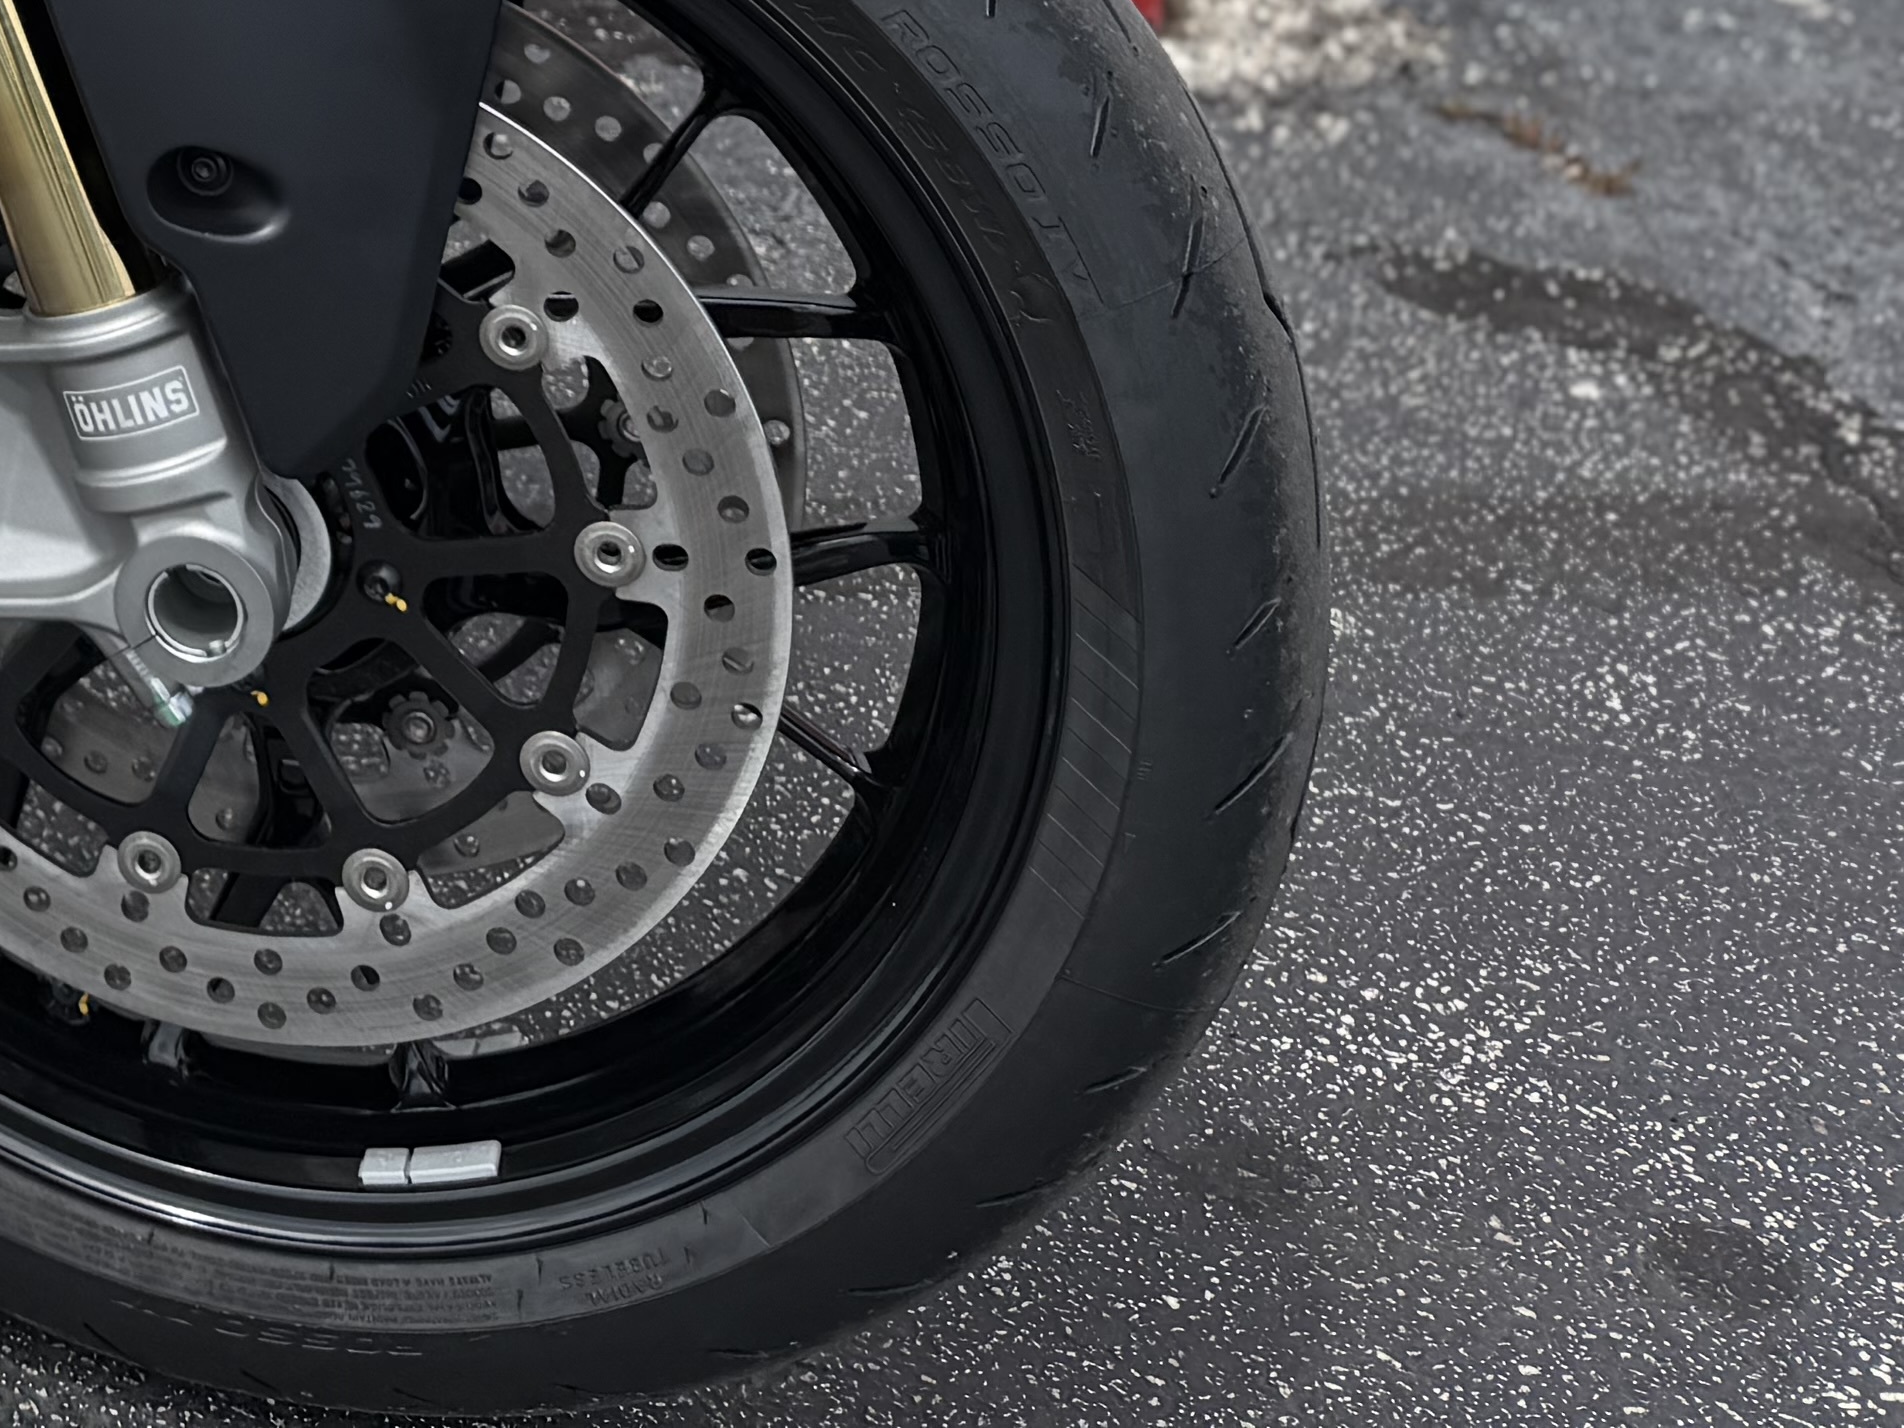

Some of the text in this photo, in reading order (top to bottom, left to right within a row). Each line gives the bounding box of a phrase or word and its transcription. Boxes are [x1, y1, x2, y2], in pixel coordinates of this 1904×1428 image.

[881, 8, 1047, 203] ROSSO
[76, 378, 190, 437] ÖHLINS
[843, 997, 1014, 1176] PIRELLI
[557, 1247, 670, 1291] TUBELESS
[584, 1274, 664, 1306] RADIAL
